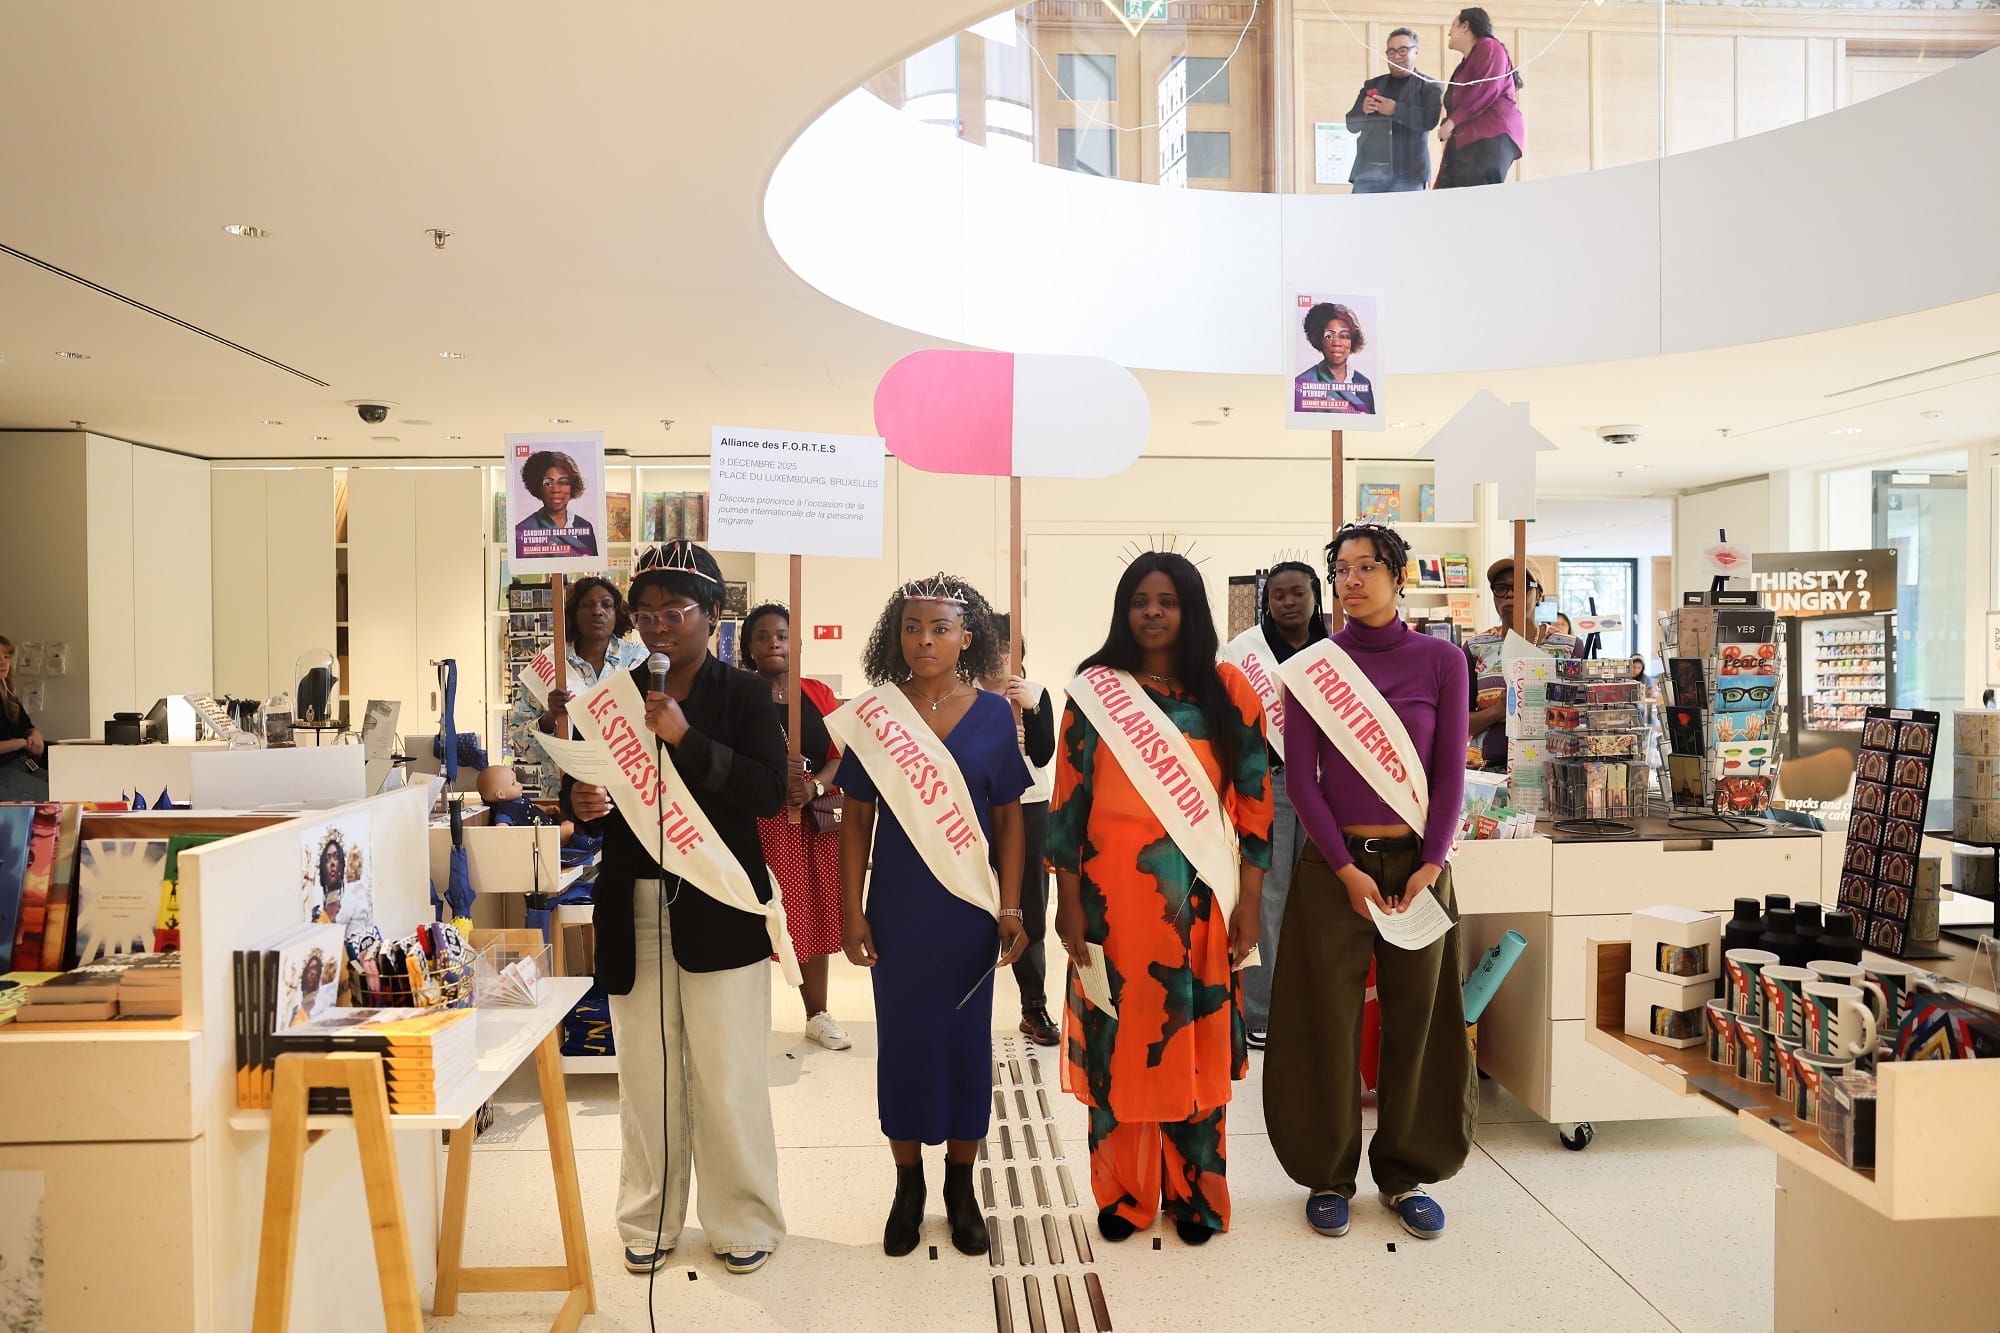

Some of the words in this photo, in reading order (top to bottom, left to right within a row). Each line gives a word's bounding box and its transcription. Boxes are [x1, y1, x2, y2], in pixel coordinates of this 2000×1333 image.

[1347, 384, 1369, 392] PAPIERS
[720, 437, 759, 448] Alliance
[762, 440, 779, 449] des
[782, 442, 836, 453] F.O.R.T.E.S
[719, 458, 726, 466] 9
[777, 462, 798, 470] 2025
[720, 471, 747, 480] PLACE
[765, 475, 828, 486] LUXEMBOURG,
[830, 478, 879, 488] BRUXELLES
[719, 493, 755, 504] Discours
[757, 497, 795, 507] prononcé
[804, 499, 843, 509] l'occasion
[845, 502, 856, 510] de
[858, 502, 865, 510] la
[718, 504, 749, 514] journée
[751, 507, 804, 518] internationale
[805, 510, 816, 518] de
[818, 511, 825, 519] la
[827, 513, 864, 521] personne
[718, 517, 754, 526] migrante
[523, 529, 551, 537] CANDIDATE
[523, 536, 548, 544] D'EUROPE
[1750, 570, 1850, 591] THIRSTY
[1855, 569, 1868, 589] ?
[1761, 591, 1853, 611] UNGRY
[1858, 590, 1871, 610] ?
[1736, 625, 1756, 634] YES
[1723, 654, 1767, 669] Peace
[1241, 653, 1275, 702] SANTE
[587, 688, 618, 724] LE
[1305, 657, 1407, 783] FRONTIERES
[1082, 664, 1210, 827] REGULARISATION
[602, 715, 667, 806] STRESS
[855, 696, 889, 728] LE
[875, 720, 948, 805] STRESS
[936, 801, 977, 856] TUE
[1820, 799, 1842, 809] and
[657, 801, 704, 855] TUE
